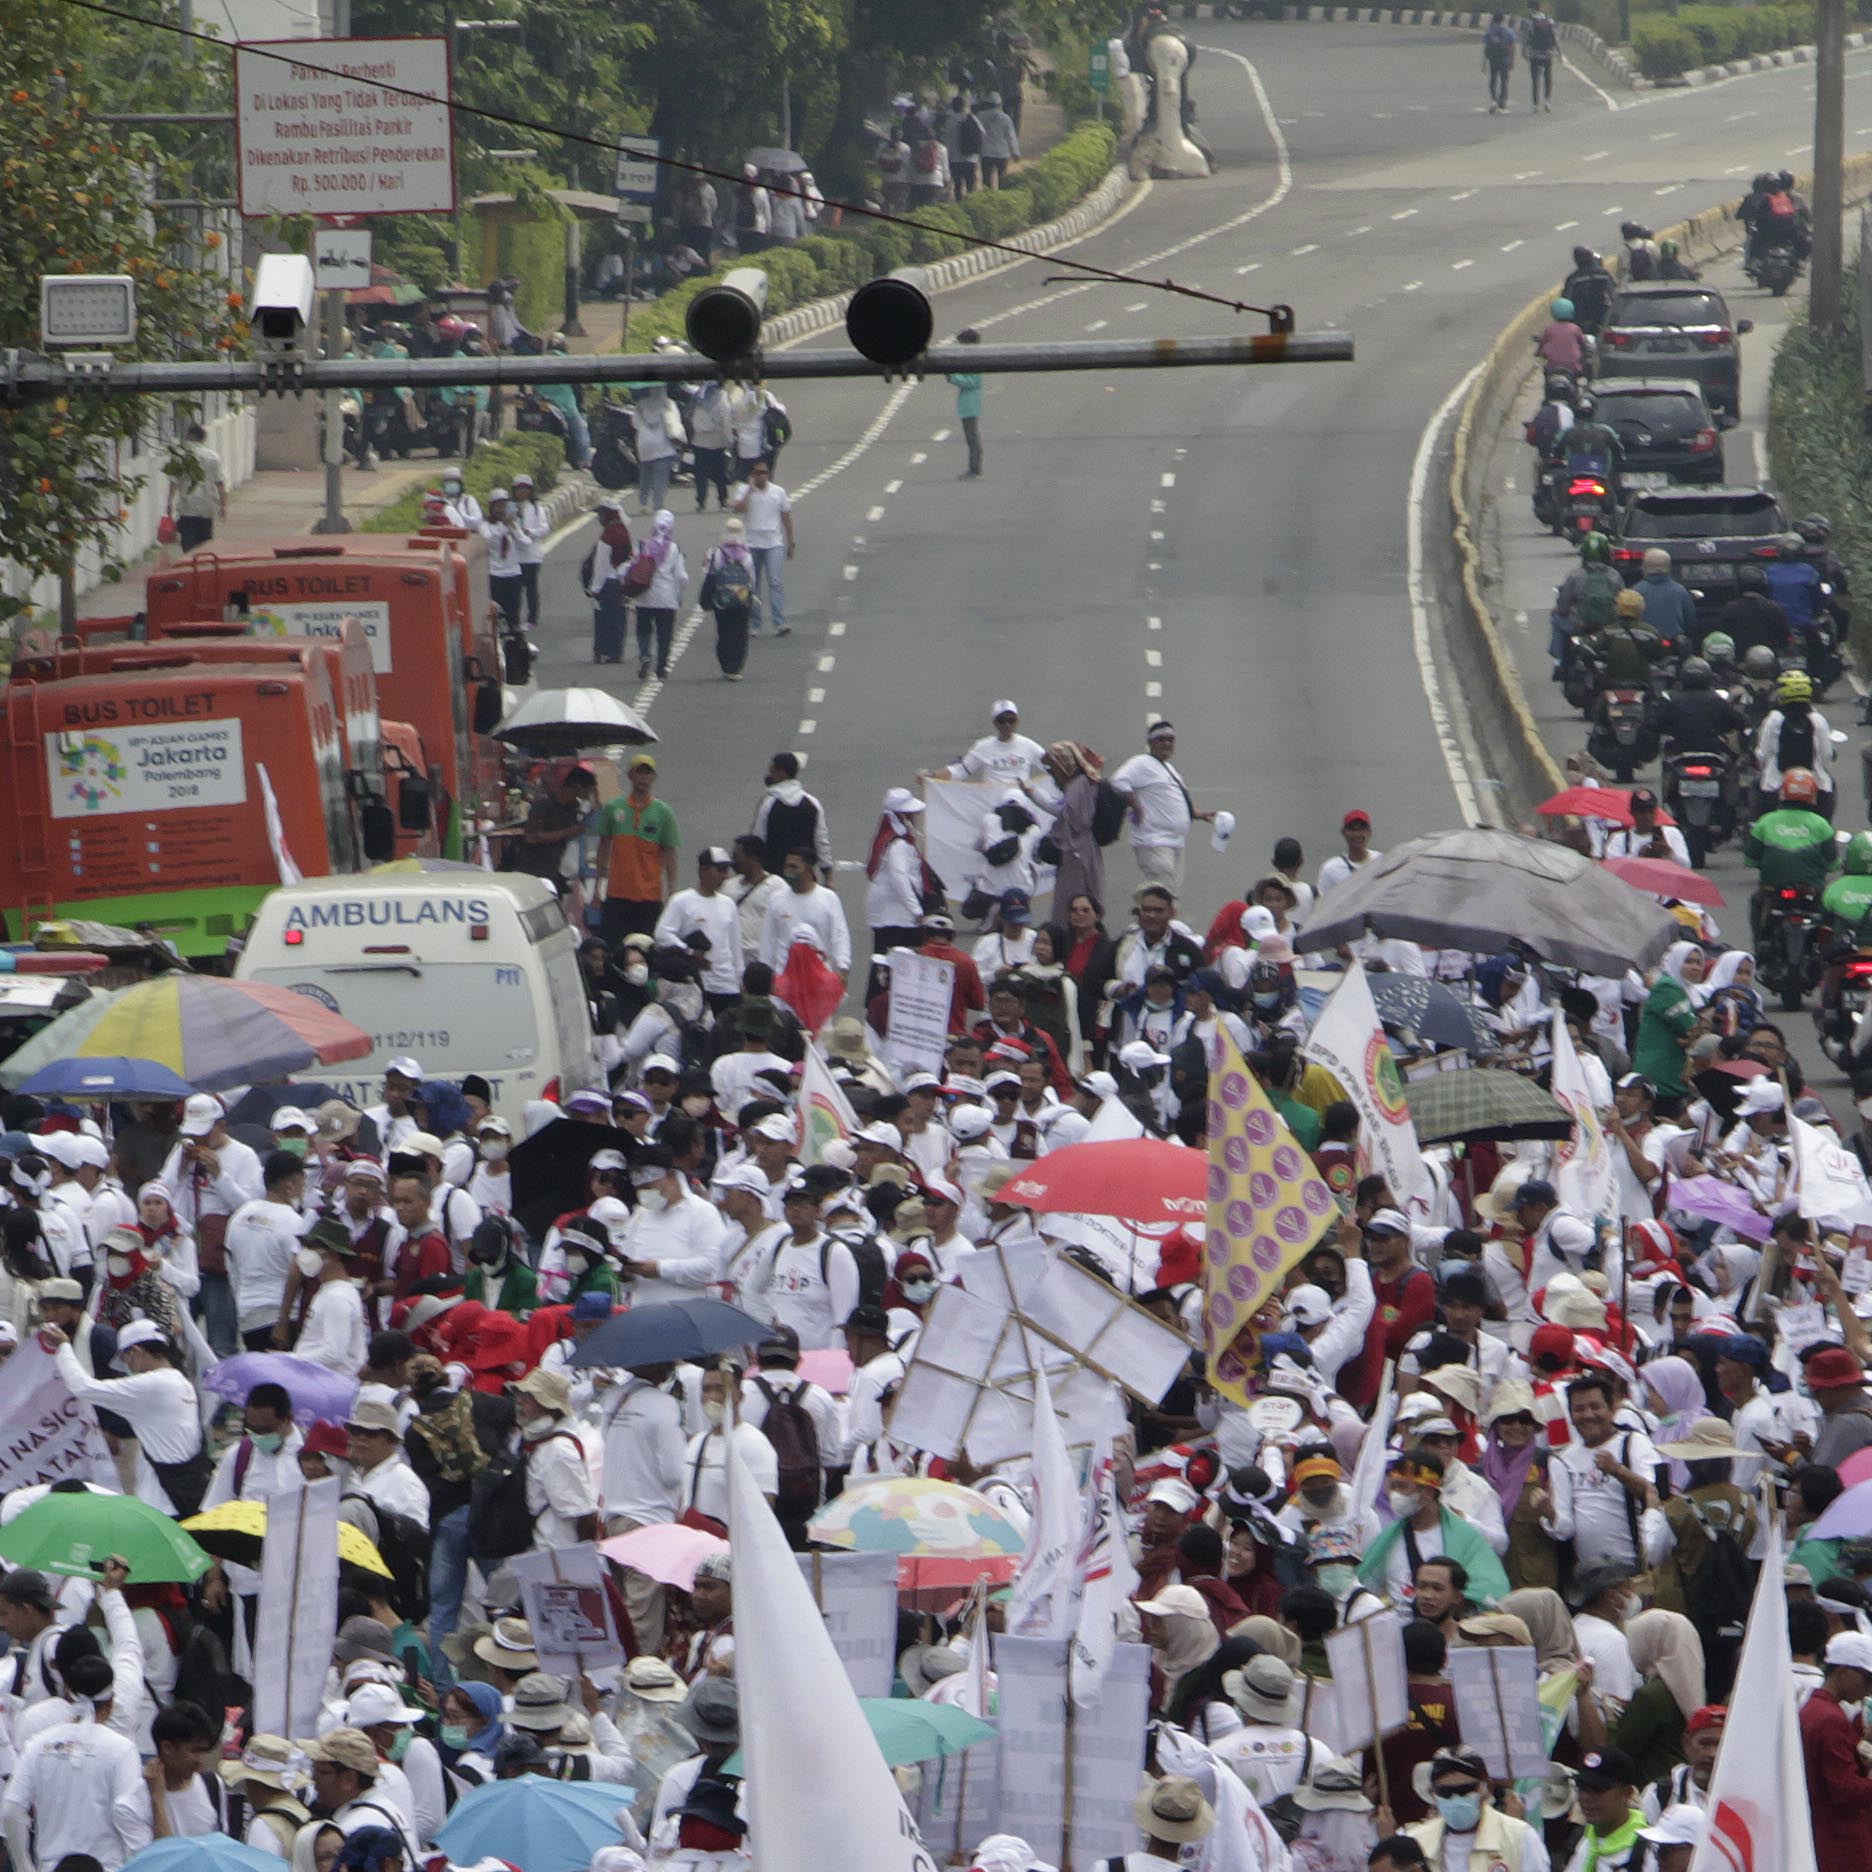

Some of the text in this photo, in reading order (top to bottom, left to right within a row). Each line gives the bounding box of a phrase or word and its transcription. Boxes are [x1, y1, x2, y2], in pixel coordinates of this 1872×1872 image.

[268, 92, 309, 110] Lokasi
[312, 93, 342, 113] Yang
[343, 90, 378, 108] Tidak
[275, 117, 413, 138] Rambu Fasilitas Parkir
[247, 145, 446, 166] Dikenakan Retribusi Penderekan
[292, 174, 311, 194] Rp.
[314, 173, 367, 191] 500.000
[378, 171, 404, 190] Hari
[242, 575, 372, 597] BUS TOILET
[64, 693, 215, 724] BUS TOILET
[136, 744, 227, 767] Jakarta
[143, 767, 221, 785] Palembang
[168, 784, 200, 798] 2018
[286, 900, 490, 929] AMBULANS
